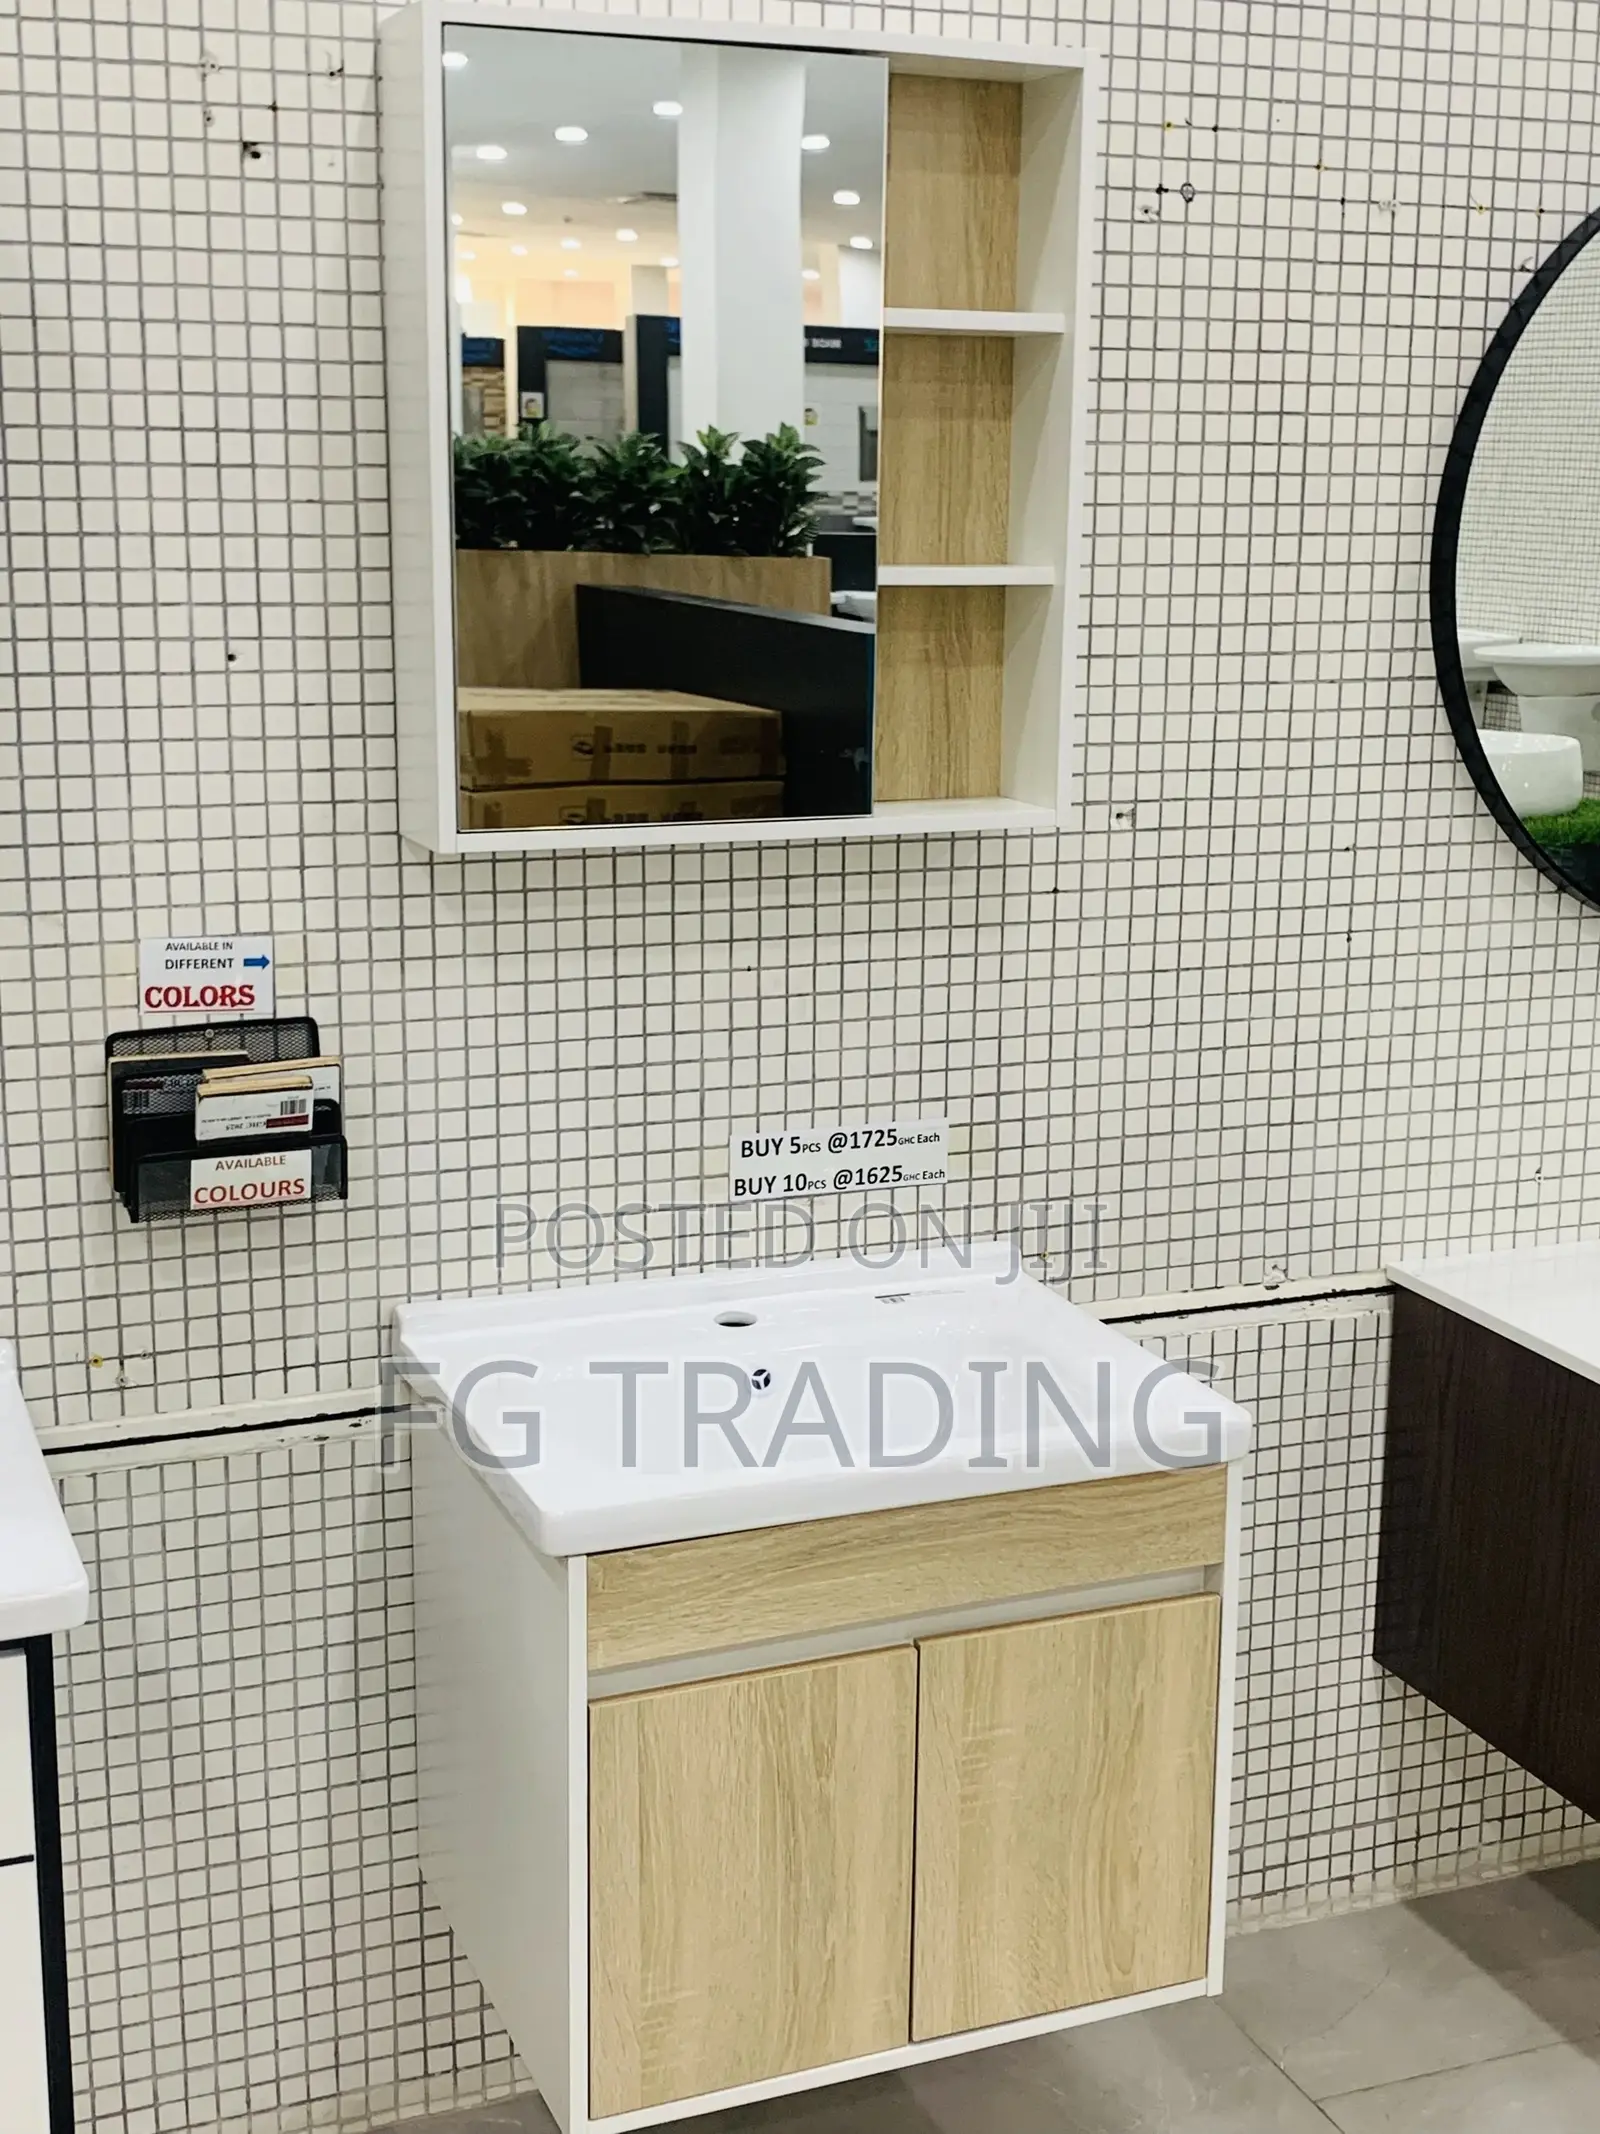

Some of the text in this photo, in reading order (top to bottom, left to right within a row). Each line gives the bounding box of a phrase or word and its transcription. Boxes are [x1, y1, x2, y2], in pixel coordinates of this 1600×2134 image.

[165, 941, 233, 951] AVAILABLE IN
[165, 958, 234, 970] DIFFERENT
[144, 984, 256, 1009] COLORS
[741, 1137, 784, 1158] BUY
[917, 1132, 941, 1144] Each
[215, 1155, 286, 1171] AVAILABLE
[194, 1178, 305, 1204] COLOURS
[734, 1175, 777, 1197] BUY
[922, 1169, 946, 1180] Each
